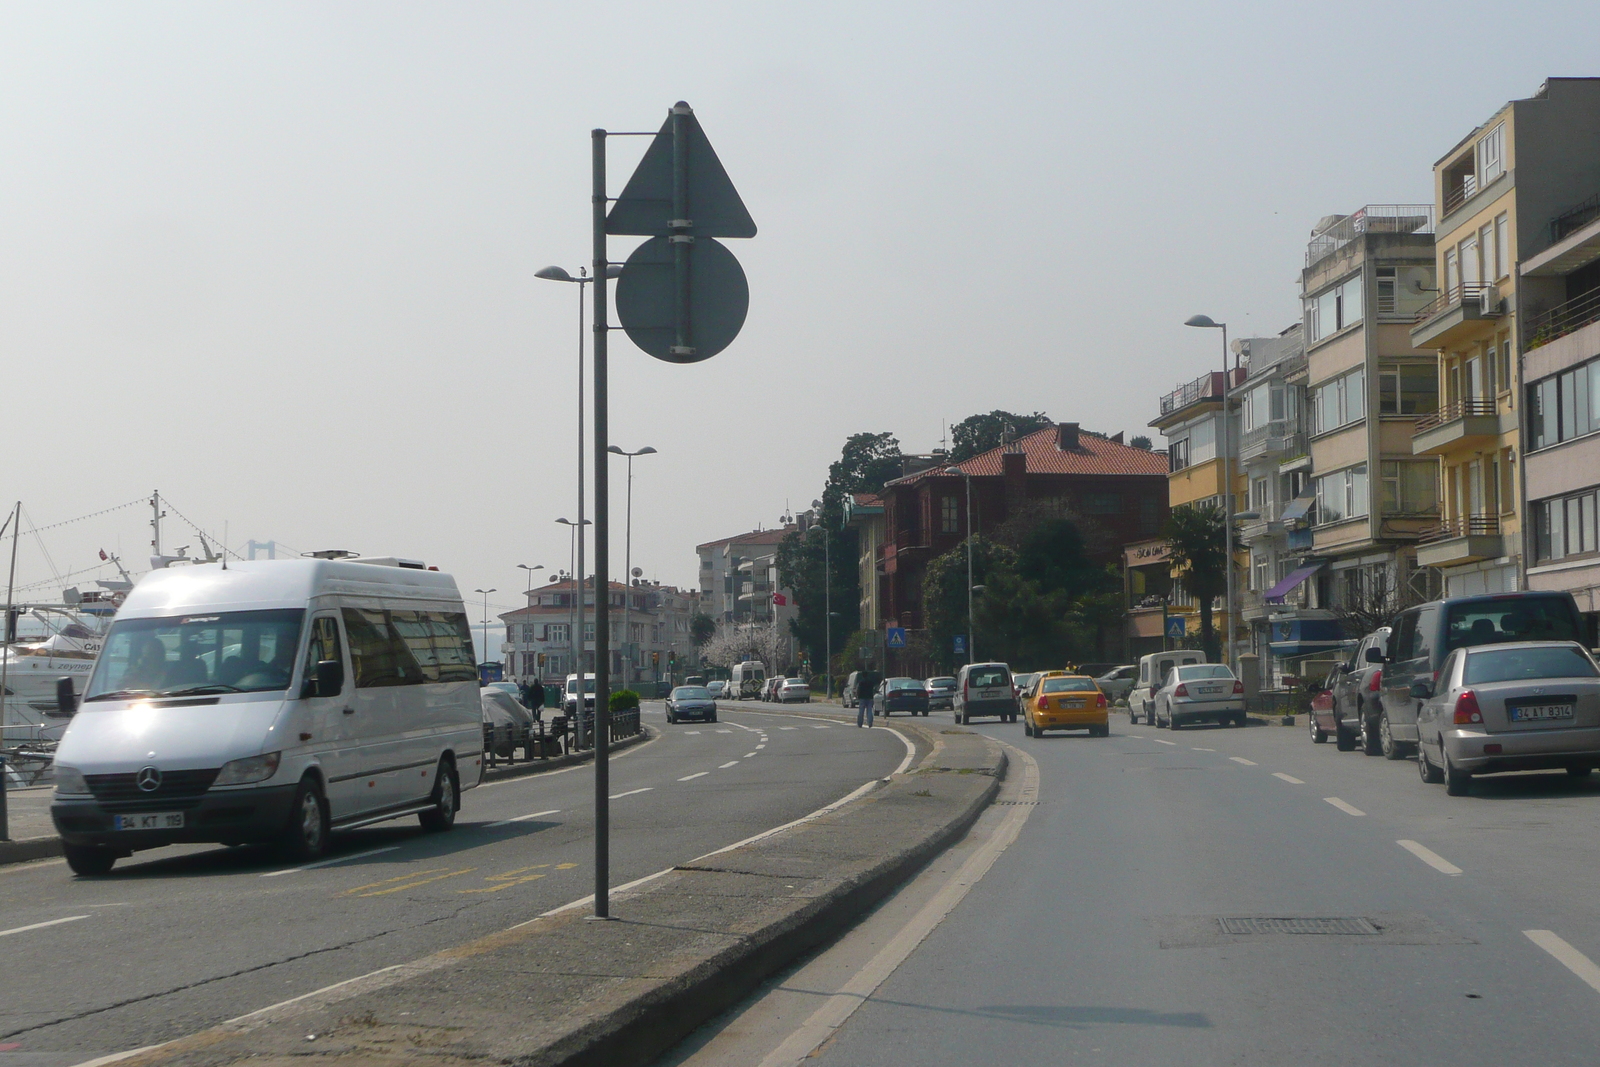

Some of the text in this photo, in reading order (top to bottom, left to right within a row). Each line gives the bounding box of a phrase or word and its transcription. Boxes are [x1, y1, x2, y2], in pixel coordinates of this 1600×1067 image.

[58, 663, 93, 671] zeynep
[1517, 706, 1571, 718] 34 AT 8314
[122, 814, 182, 828] 34 KT 119
